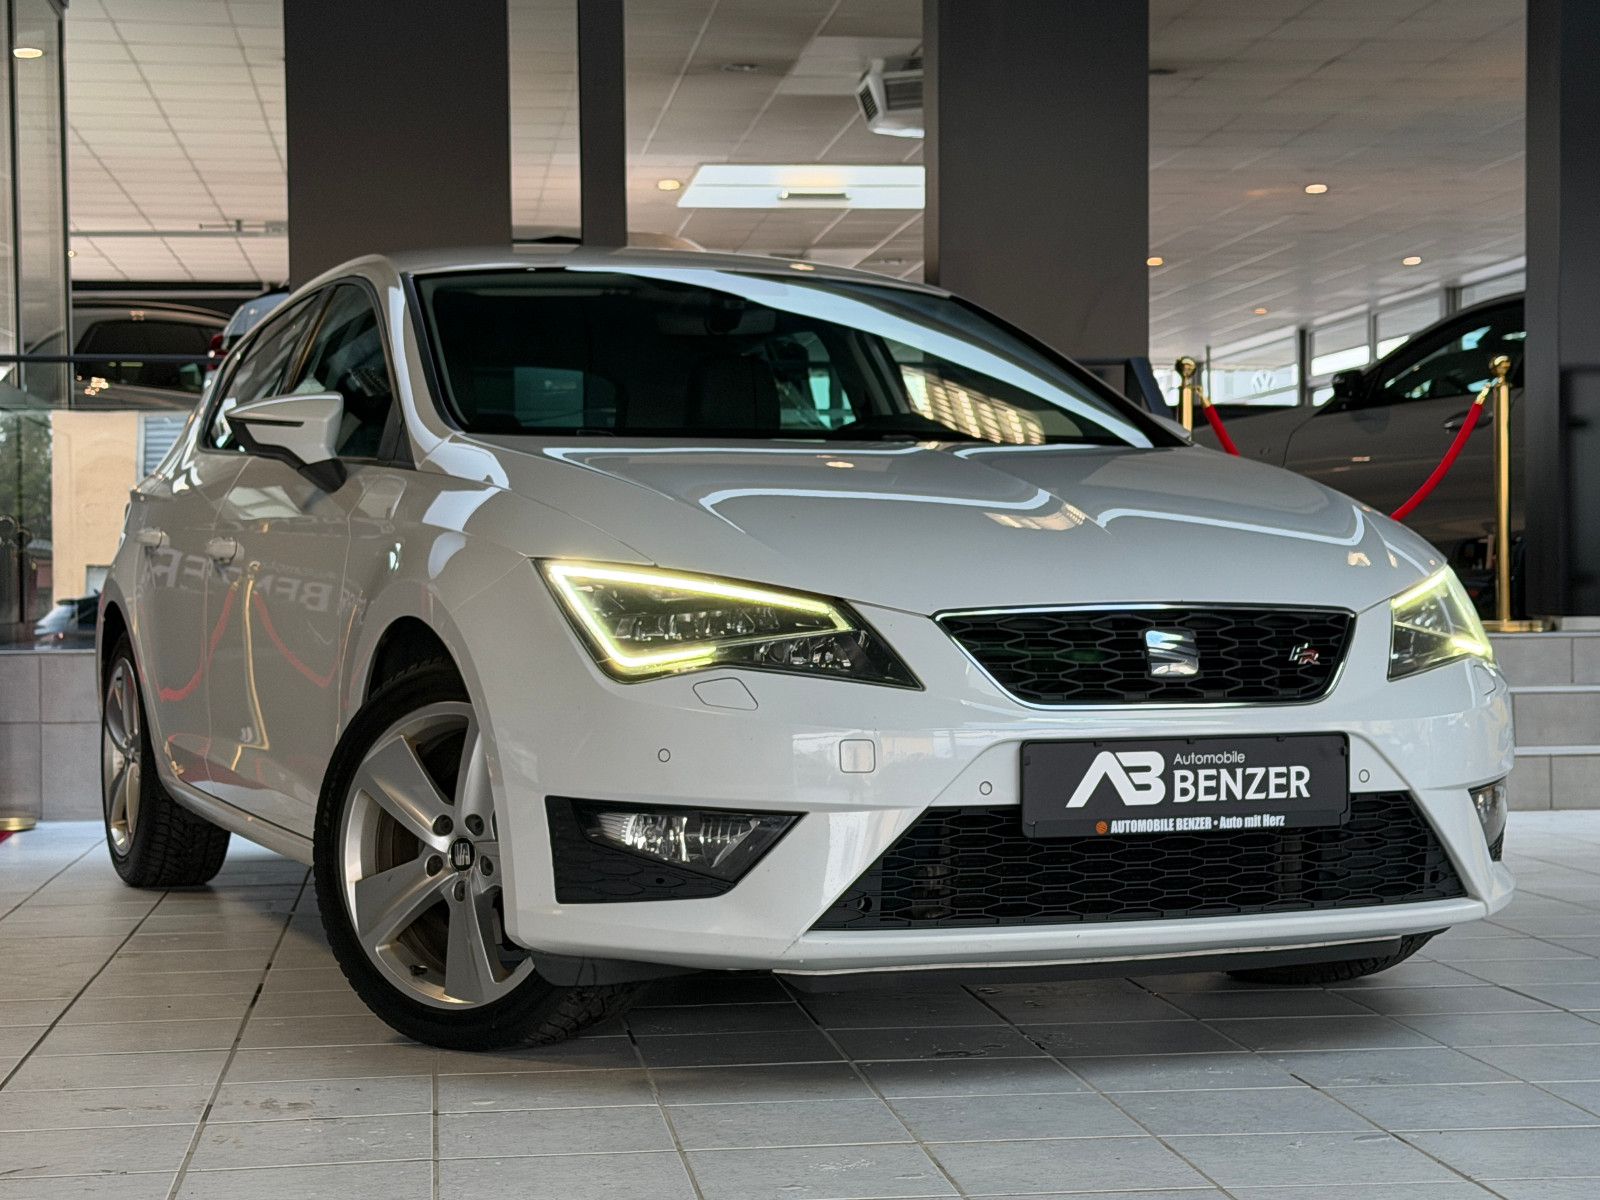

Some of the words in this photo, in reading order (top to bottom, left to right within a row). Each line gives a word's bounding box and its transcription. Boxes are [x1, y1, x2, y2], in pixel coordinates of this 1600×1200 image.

[1173, 751, 1246, 765] Automobile
[1066, 750, 1166, 808] AB
[1172, 766, 1311, 804] BENZER
[1110, 818, 1175, 834] AUTOMOBILE
[1177, 817, 1212, 831] BENZER
[1219, 815, 1243, 829] Auto
[1244, 815, 1261, 827] mit
[1262, 814, 1285, 827] Herz
